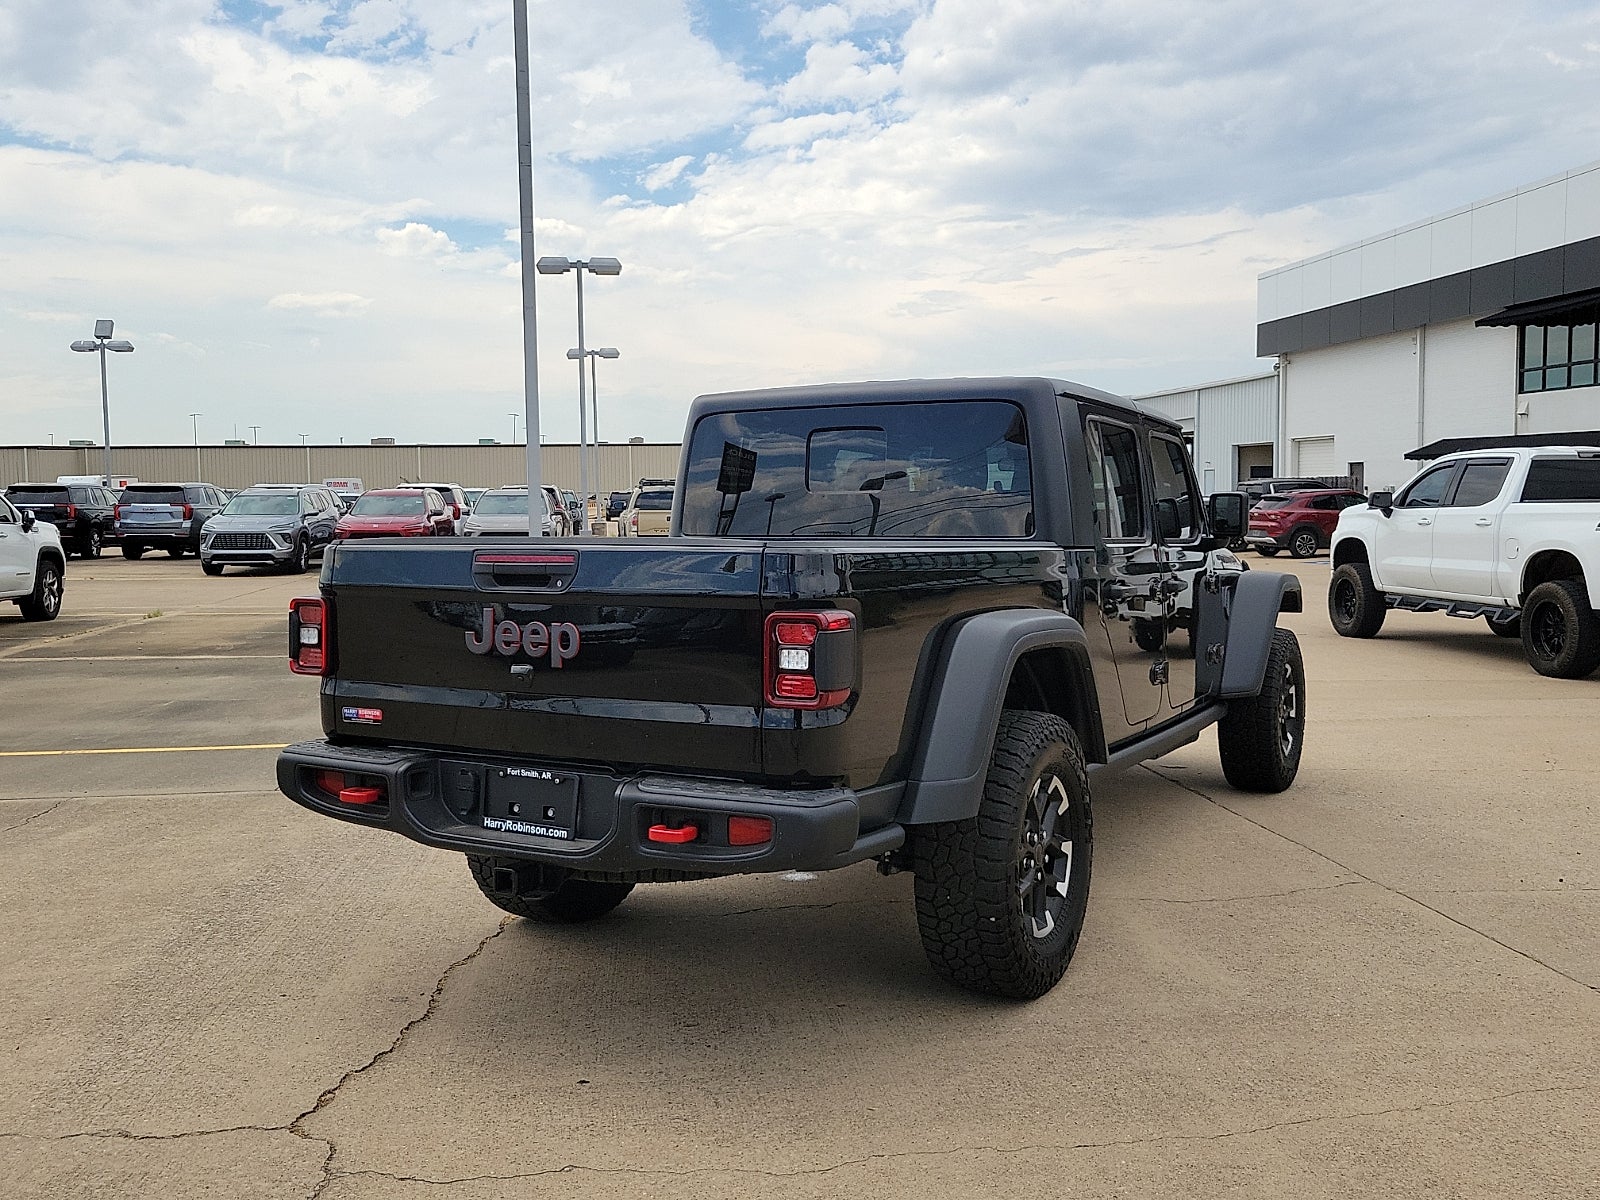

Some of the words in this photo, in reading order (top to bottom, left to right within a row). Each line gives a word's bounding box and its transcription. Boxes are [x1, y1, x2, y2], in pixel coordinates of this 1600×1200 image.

[465, 607, 580, 668] Jeep
[507, 767, 521, 776] Fort
[521, 769, 541, 780] Smith,
[541, 771, 552, 780] AR
[484, 817, 567, 838] HarryRobinson.com
